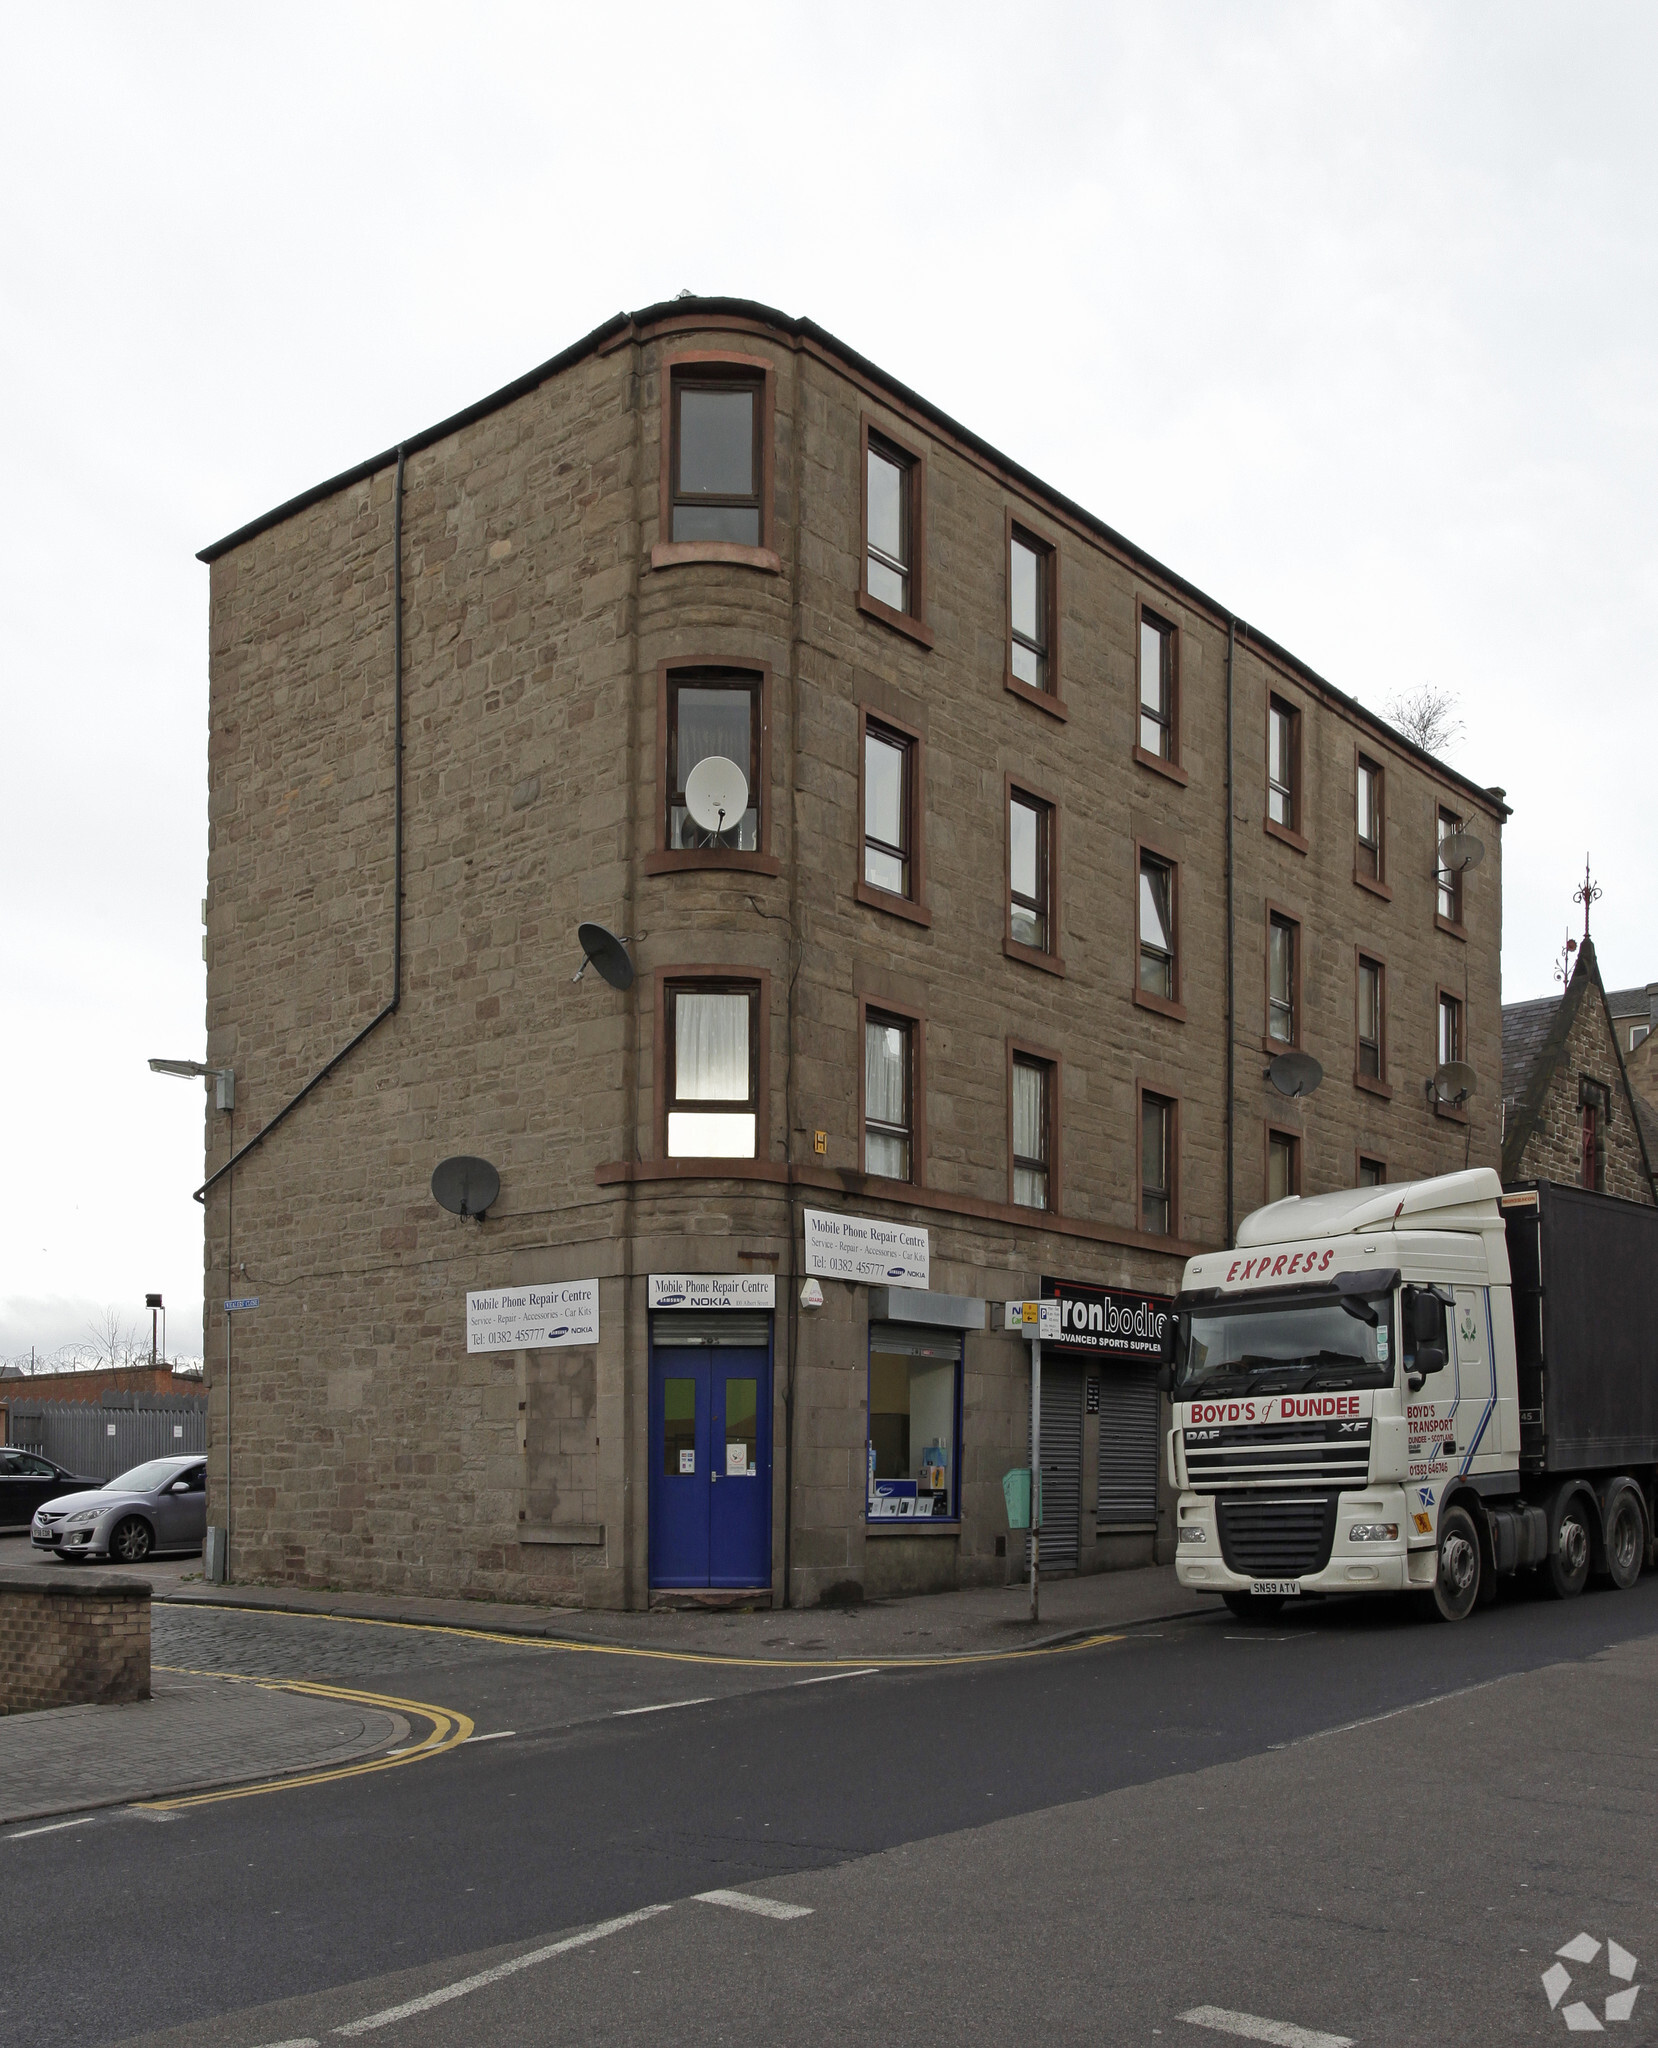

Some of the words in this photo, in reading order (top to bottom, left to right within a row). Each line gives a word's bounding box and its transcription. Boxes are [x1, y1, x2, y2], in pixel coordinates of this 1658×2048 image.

[811, 1218, 840, 1234] Mobile
[843, 1224, 868, 1239] Phone
[870, 1228, 898, 1245] Repair
[900, 1233, 925, 1247] Centre
[812, 1237, 833, 1249] Service
[840, 1241, 858, 1253] Repair
[864, 1245, 897, 1258] Accessories
[902, 1251, 913, 1260] Car
[914, 1253, 925, 1262] Kits
[812, 1255, 826, 1268] Tel:
[829, 1258, 853, 1272] 01382
[856, 1261, 885, 1276] 455777
[1226, 1250, 1334, 1282] EXPRESS
[907, 1270, 926, 1278] NOKIA
[656, 1280, 682, 1292] Mobile
[686, 1280, 709, 1292] Phone
[712, 1280, 739, 1296] Repair
[742, 1280, 768, 1292] Centre
[471, 1298, 499, 1312] Mobile
[501, 1295, 526, 1308] Phone
[529, 1292, 559, 1308] Repair
[561, 1290, 592, 1302] Centre
[691, 1298, 731, 1306] NOKIA
[471, 1317, 492, 1326] Service
[498, 1314, 516, 1325] Repair
[523, 1311, 558, 1321] Accessories
[564, 1308, 576, 1317] Car
[578, 1306, 592, 1316] Kits
[1042, 1309, 1046, 1319] P
[1055, 1290, 1180, 1338] ronbodie
[472, 1334, 485, 1345] Tel:
[488, 1331, 512, 1344] 01382
[515, 1328, 545, 1342] 455777
[1060, 1333, 1097, 1345] DVANCED
[1099, 1338, 1129, 1348] SPORTS
[1191, 1402, 1255, 1424] BOYD'S
[1260, 1399, 1277, 1424] of
[1281, 1396, 1360, 1418] DUNDEE
[1407, 1405, 1435, 1418] BOYD'S
[1338, 1422, 1369, 1432] XF
[1408, 1419, 1453, 1433] TRANSPORT
[1186, 1430, 1220, 1440] DAF
[1408, 1435, 1427, 1444] DUNDEE
[1431, 1434, 1454, 1442] SCOTLAND
[1410, 1465, 1427, 1476] 01382
[1254, 1583, 1277, 1593] SN59
[1280, 1583, 1296, 1593] ATV
